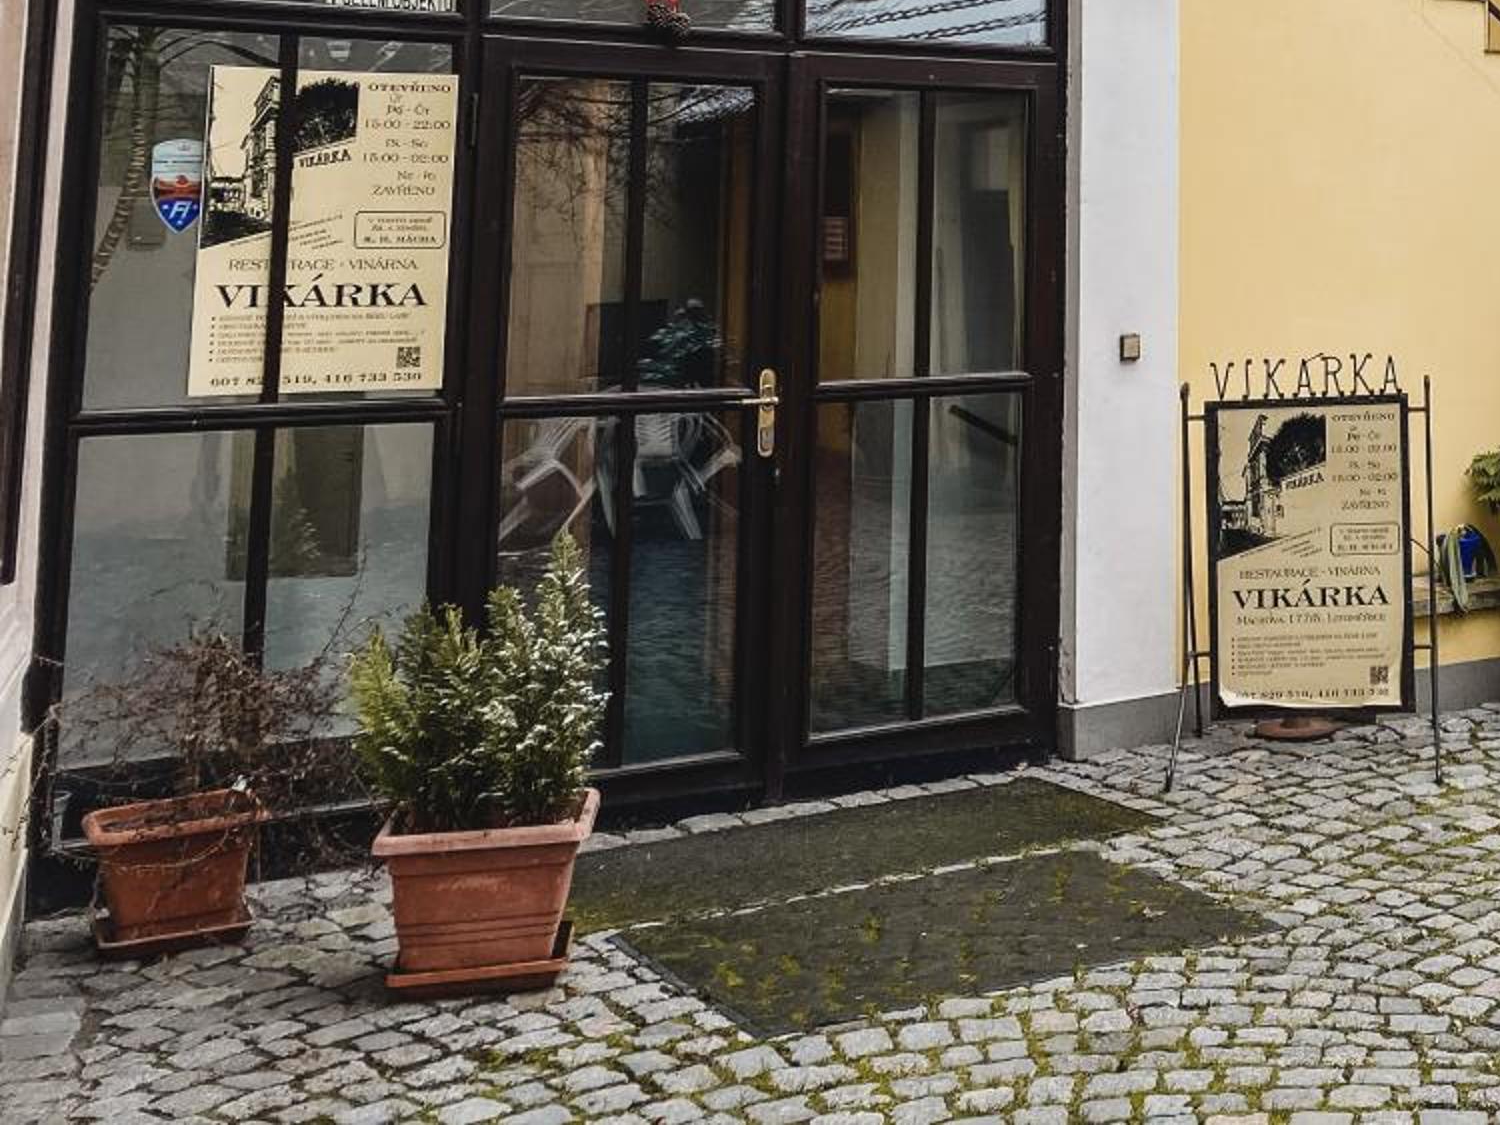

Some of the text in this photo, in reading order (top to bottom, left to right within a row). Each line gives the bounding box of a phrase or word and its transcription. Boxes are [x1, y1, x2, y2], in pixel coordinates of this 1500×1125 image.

[368, 81, 451, 93] OTEVŘENO
[299, 149, 352, 168] VIKÁRKA
[372, 183, 436, 196] ZAVŘENO
[229, 258, 335, 273] RESTRACE
[349, 257, 420, 272] VINÁRNA
[1209, 352, 1403, 401] VIKÁRKA
[1232, 578, 1391, 610] VIKÁRKA
